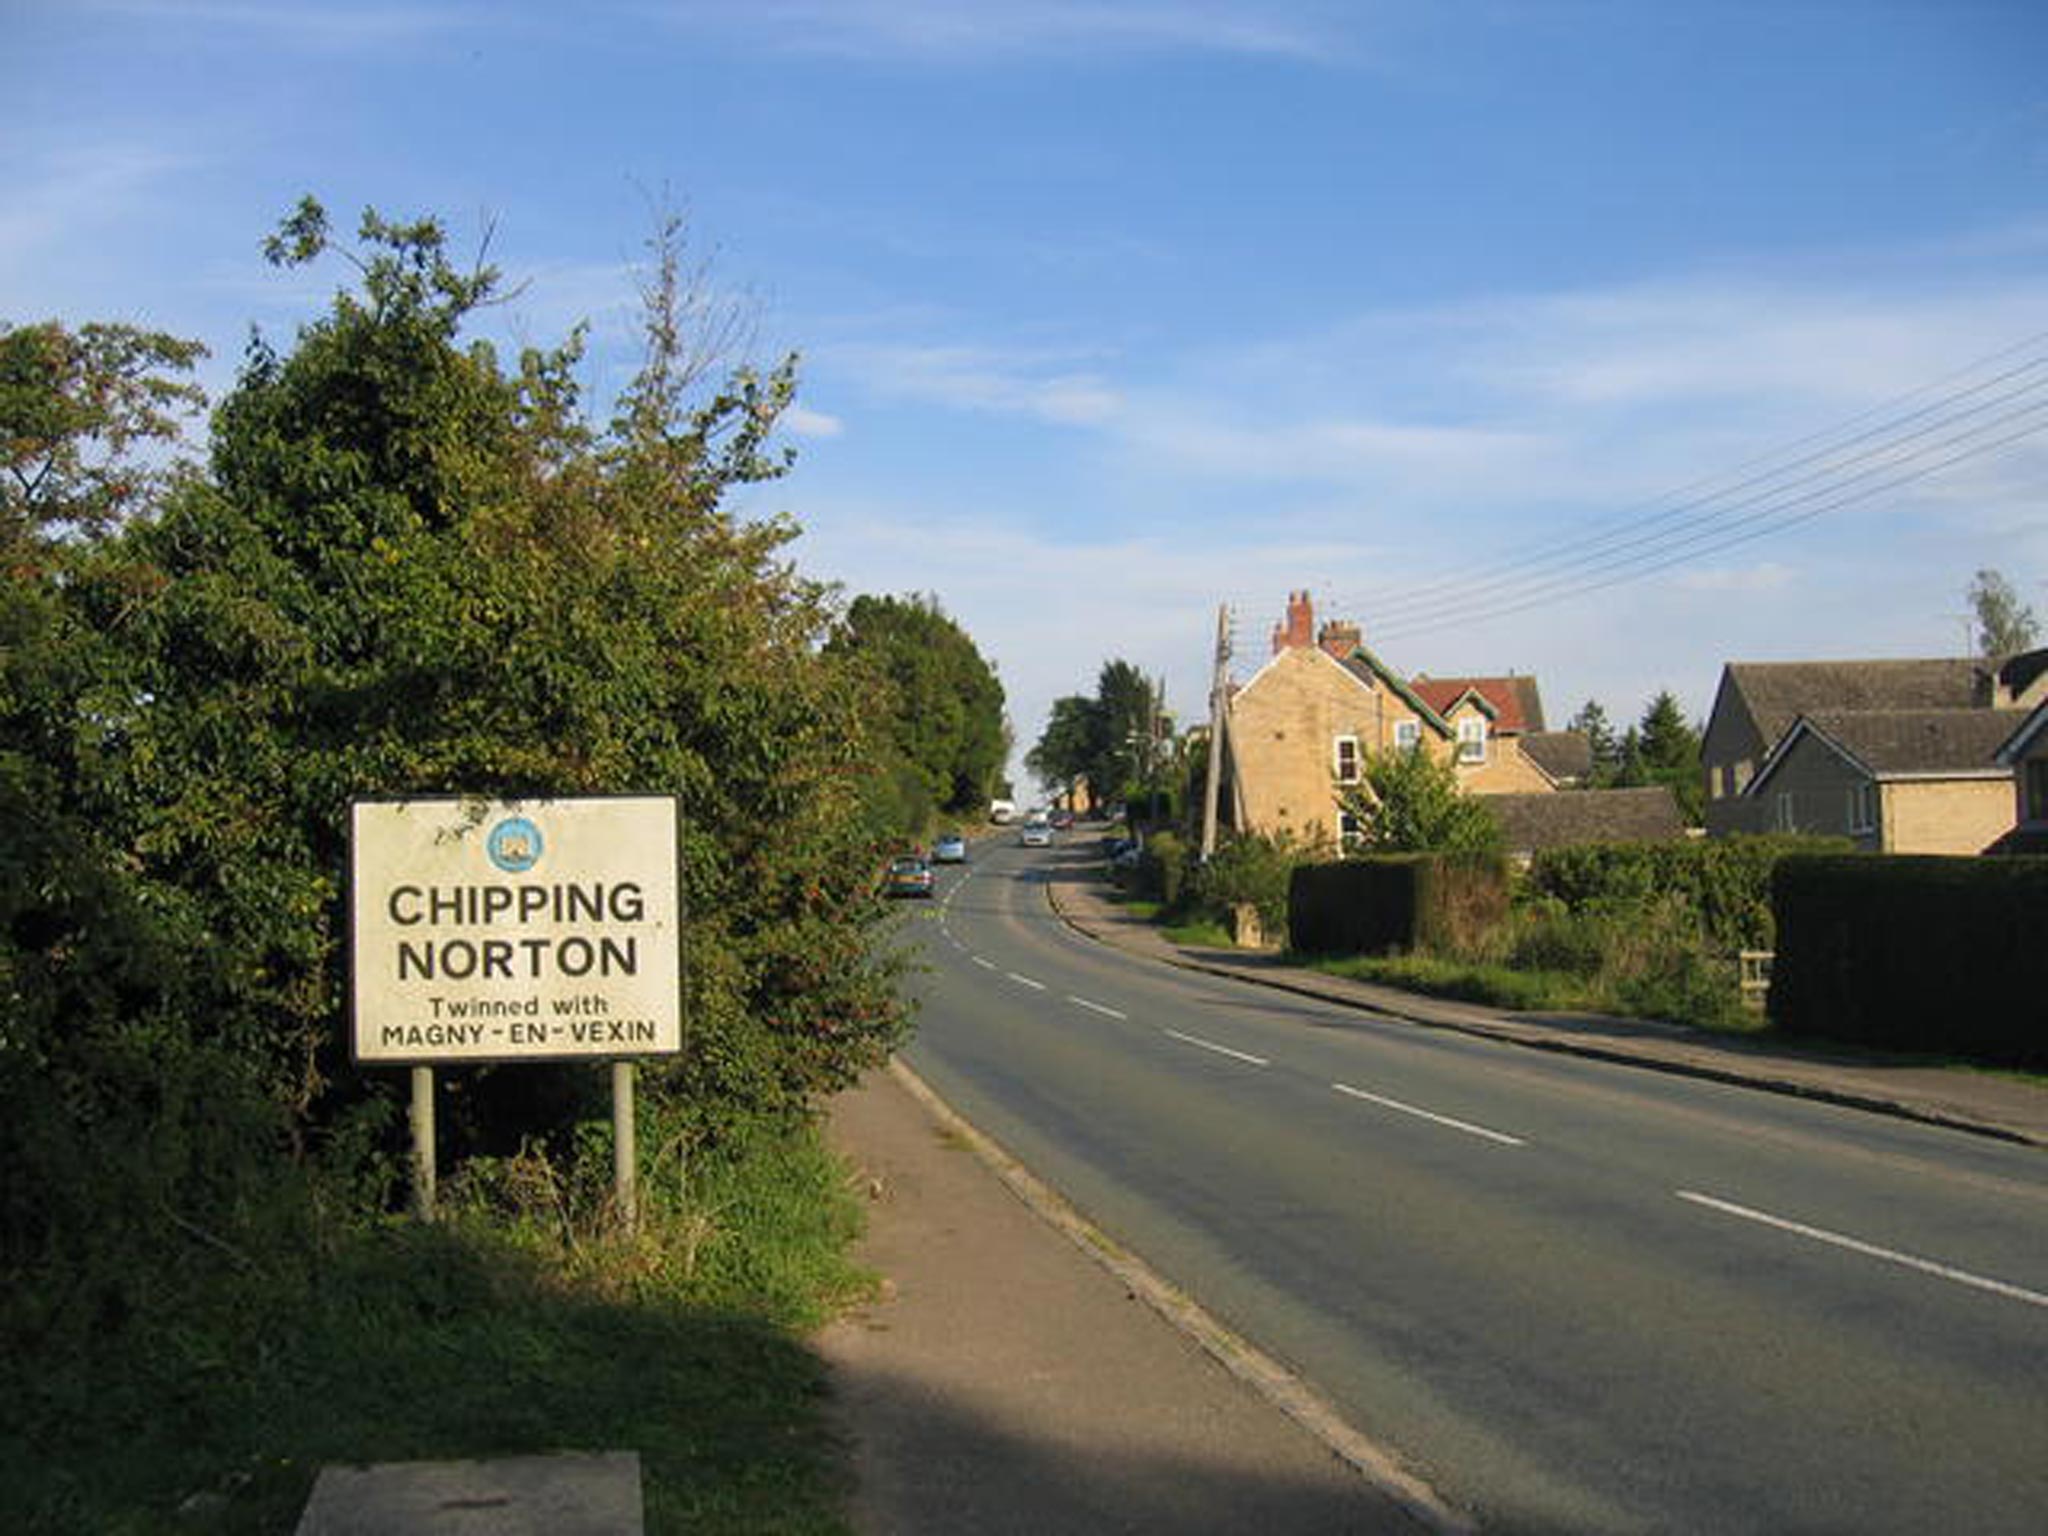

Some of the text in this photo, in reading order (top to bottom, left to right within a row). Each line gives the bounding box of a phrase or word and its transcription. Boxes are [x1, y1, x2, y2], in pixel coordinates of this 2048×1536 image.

[388, 881, 645, 926] CHIPPING
[398, 936, 637, 981] NORTON
[429, 994, 609, 1019] Twinned with
